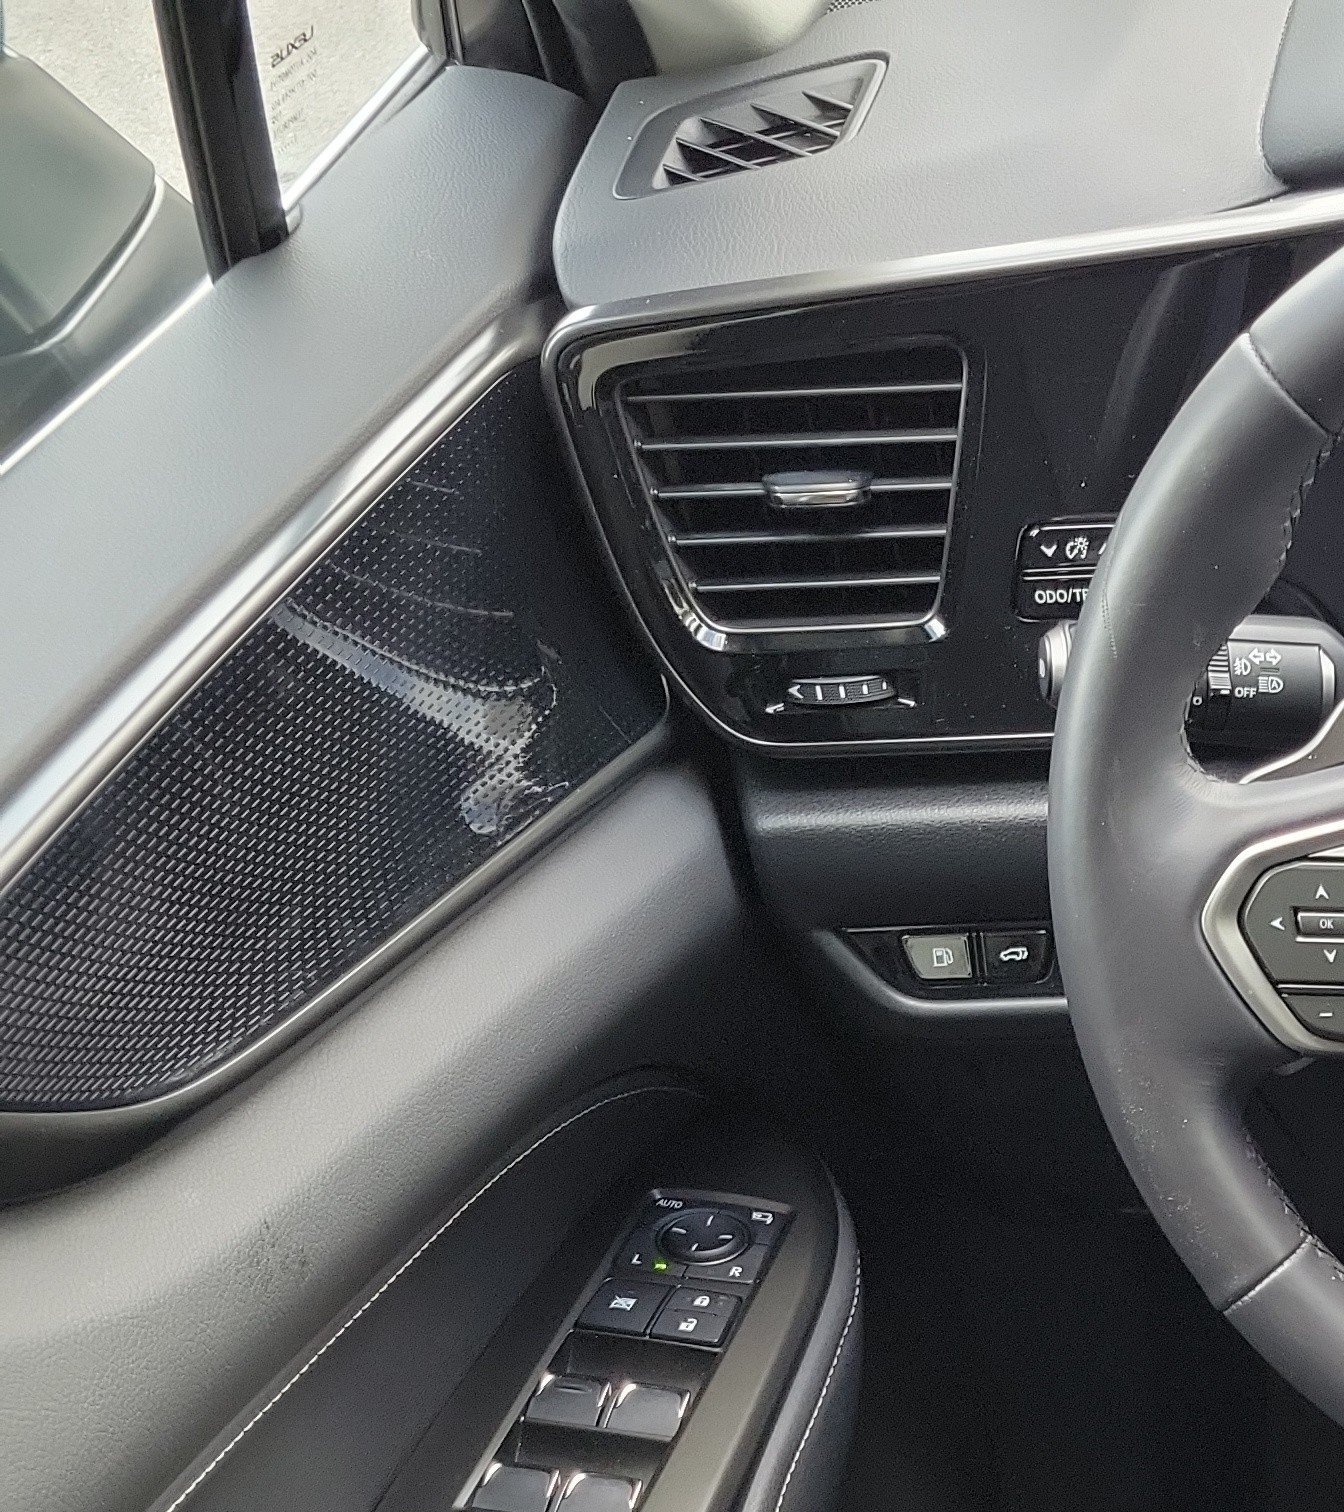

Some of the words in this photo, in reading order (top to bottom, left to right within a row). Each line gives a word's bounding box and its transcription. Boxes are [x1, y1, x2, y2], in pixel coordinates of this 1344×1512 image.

[1234, 686, 1257, 698] OFF
[1319, 918, 1334, 929] OK
[656, 1199, 683, 1209] AUTO
[632, 1254, 642, 1265] L
[729, 1266, 742, 1277] R
